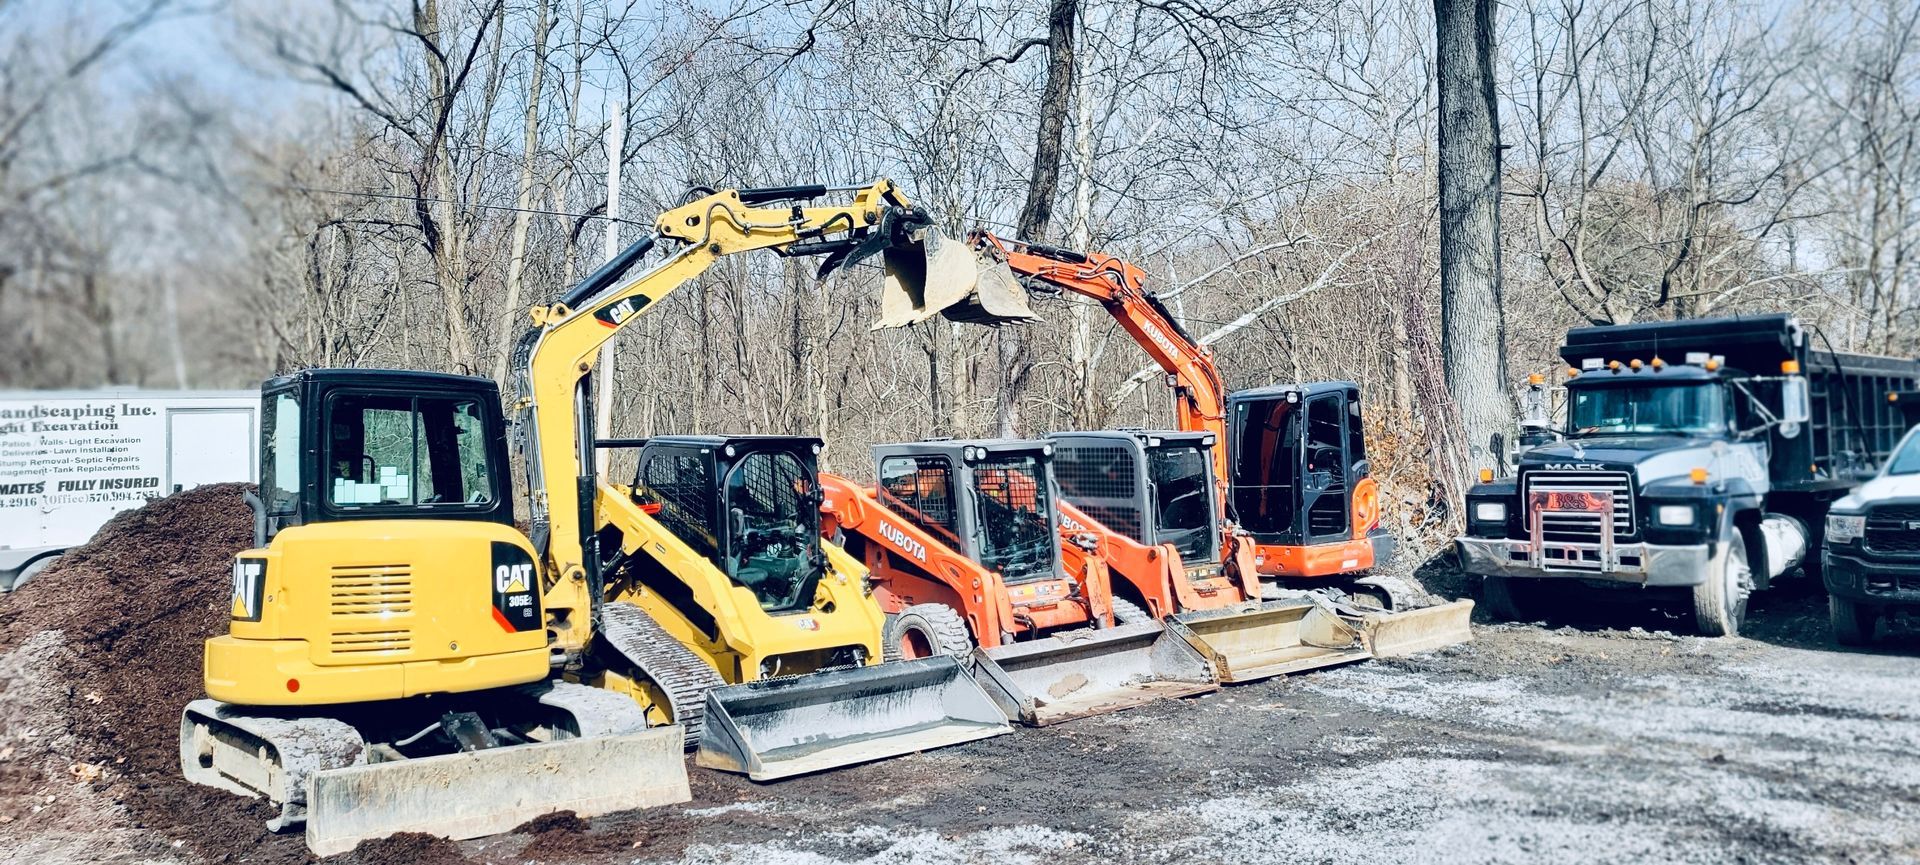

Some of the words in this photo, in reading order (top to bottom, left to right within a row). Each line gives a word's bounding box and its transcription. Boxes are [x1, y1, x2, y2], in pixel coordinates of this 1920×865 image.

[609, 297, 636, 324] CAT
[1143, 320, 1179, 361] KUBOTA
[0, 404, 115, 420] andscaping
[121, 403, 156, 416] Inc.
[31, 420, 119, 433] Excavation
[106, 455, 140, 463] Repairs
[1544, 463, 1605, 471] MACK
[77, 464, 140, 473] Replacements
[57, 480, 97, 492] FULLY
[99, 477, 159, 490] INSURED
[1550, 492, 1589, 509] B&S
[879, 520, 927, 563] KUBOTA
[496, 564, 532, 593] CAT
